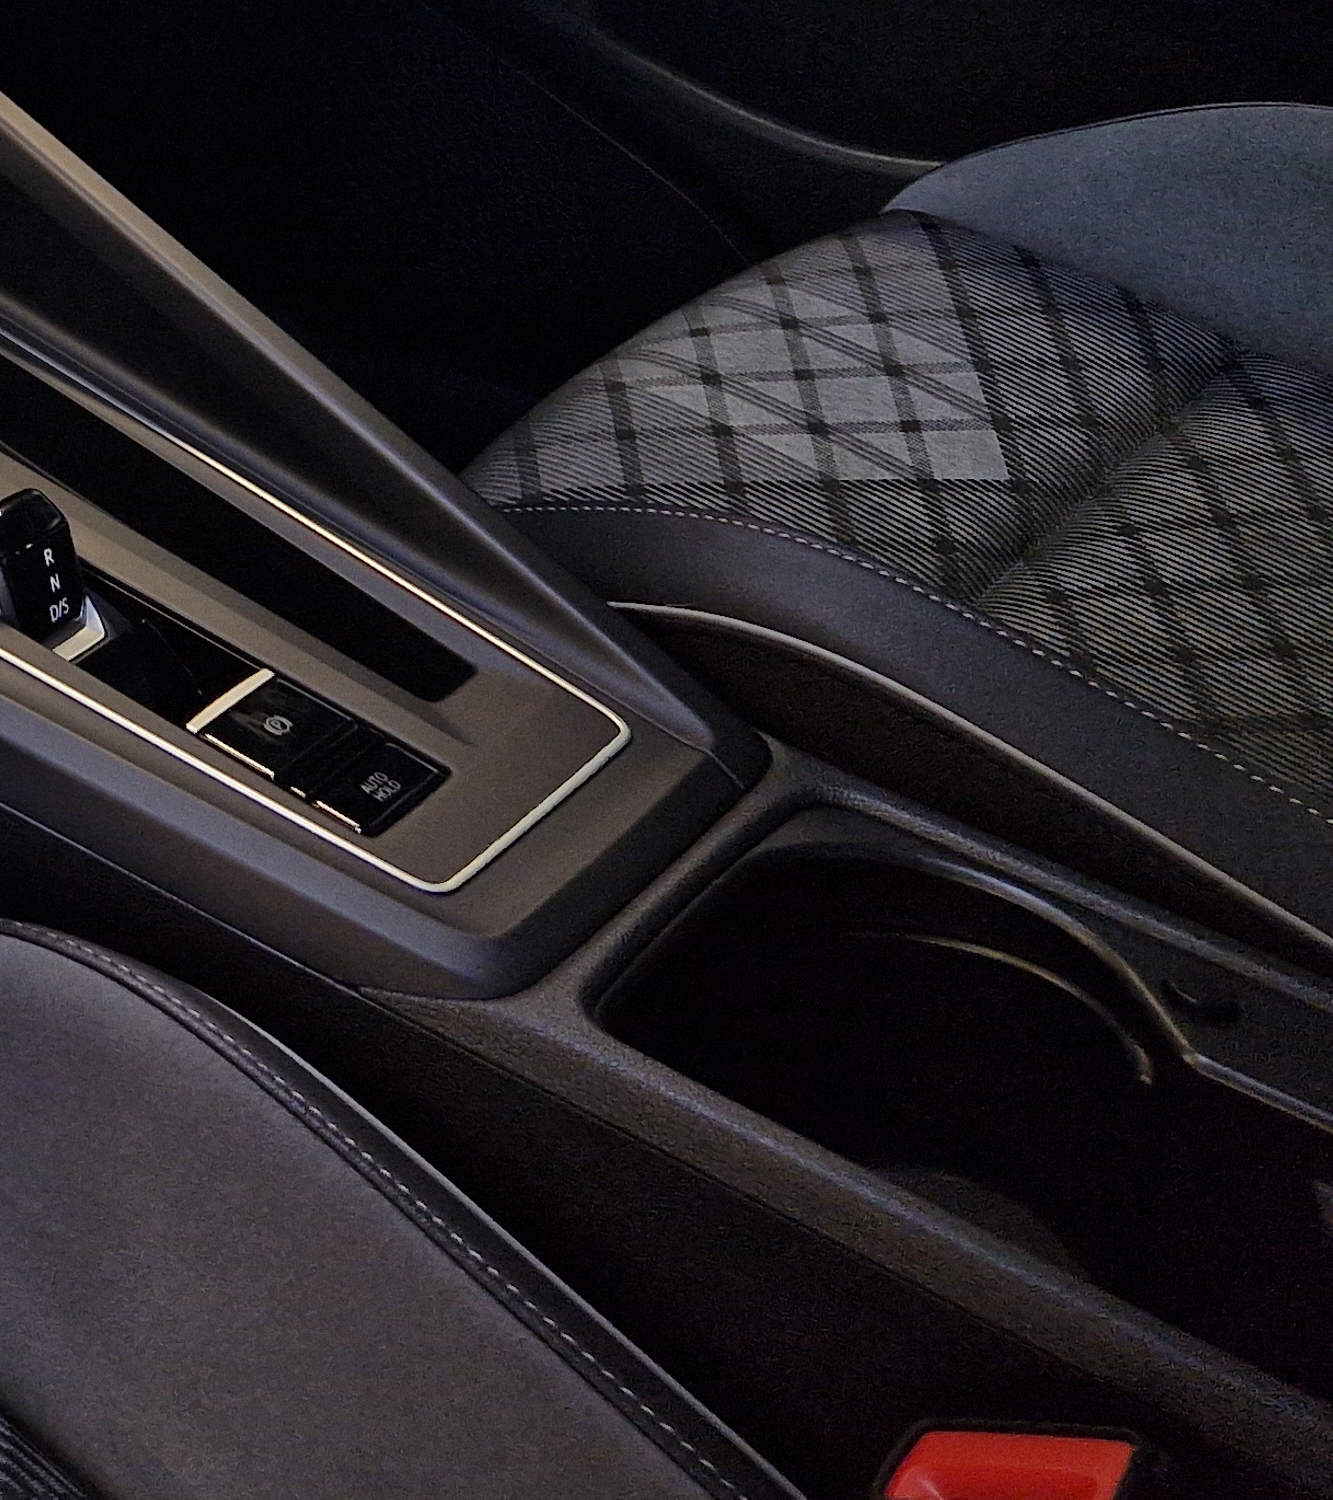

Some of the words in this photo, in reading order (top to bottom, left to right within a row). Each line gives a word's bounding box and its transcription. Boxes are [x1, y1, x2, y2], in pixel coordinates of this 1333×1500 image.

[43, 547, 55, 567] R
[49, 572, 61, 593] N
[49, 596, 70, 623] D/S
[358, 771, 388, 795] AUTO
[370, 780, 402, 802] HOLD
